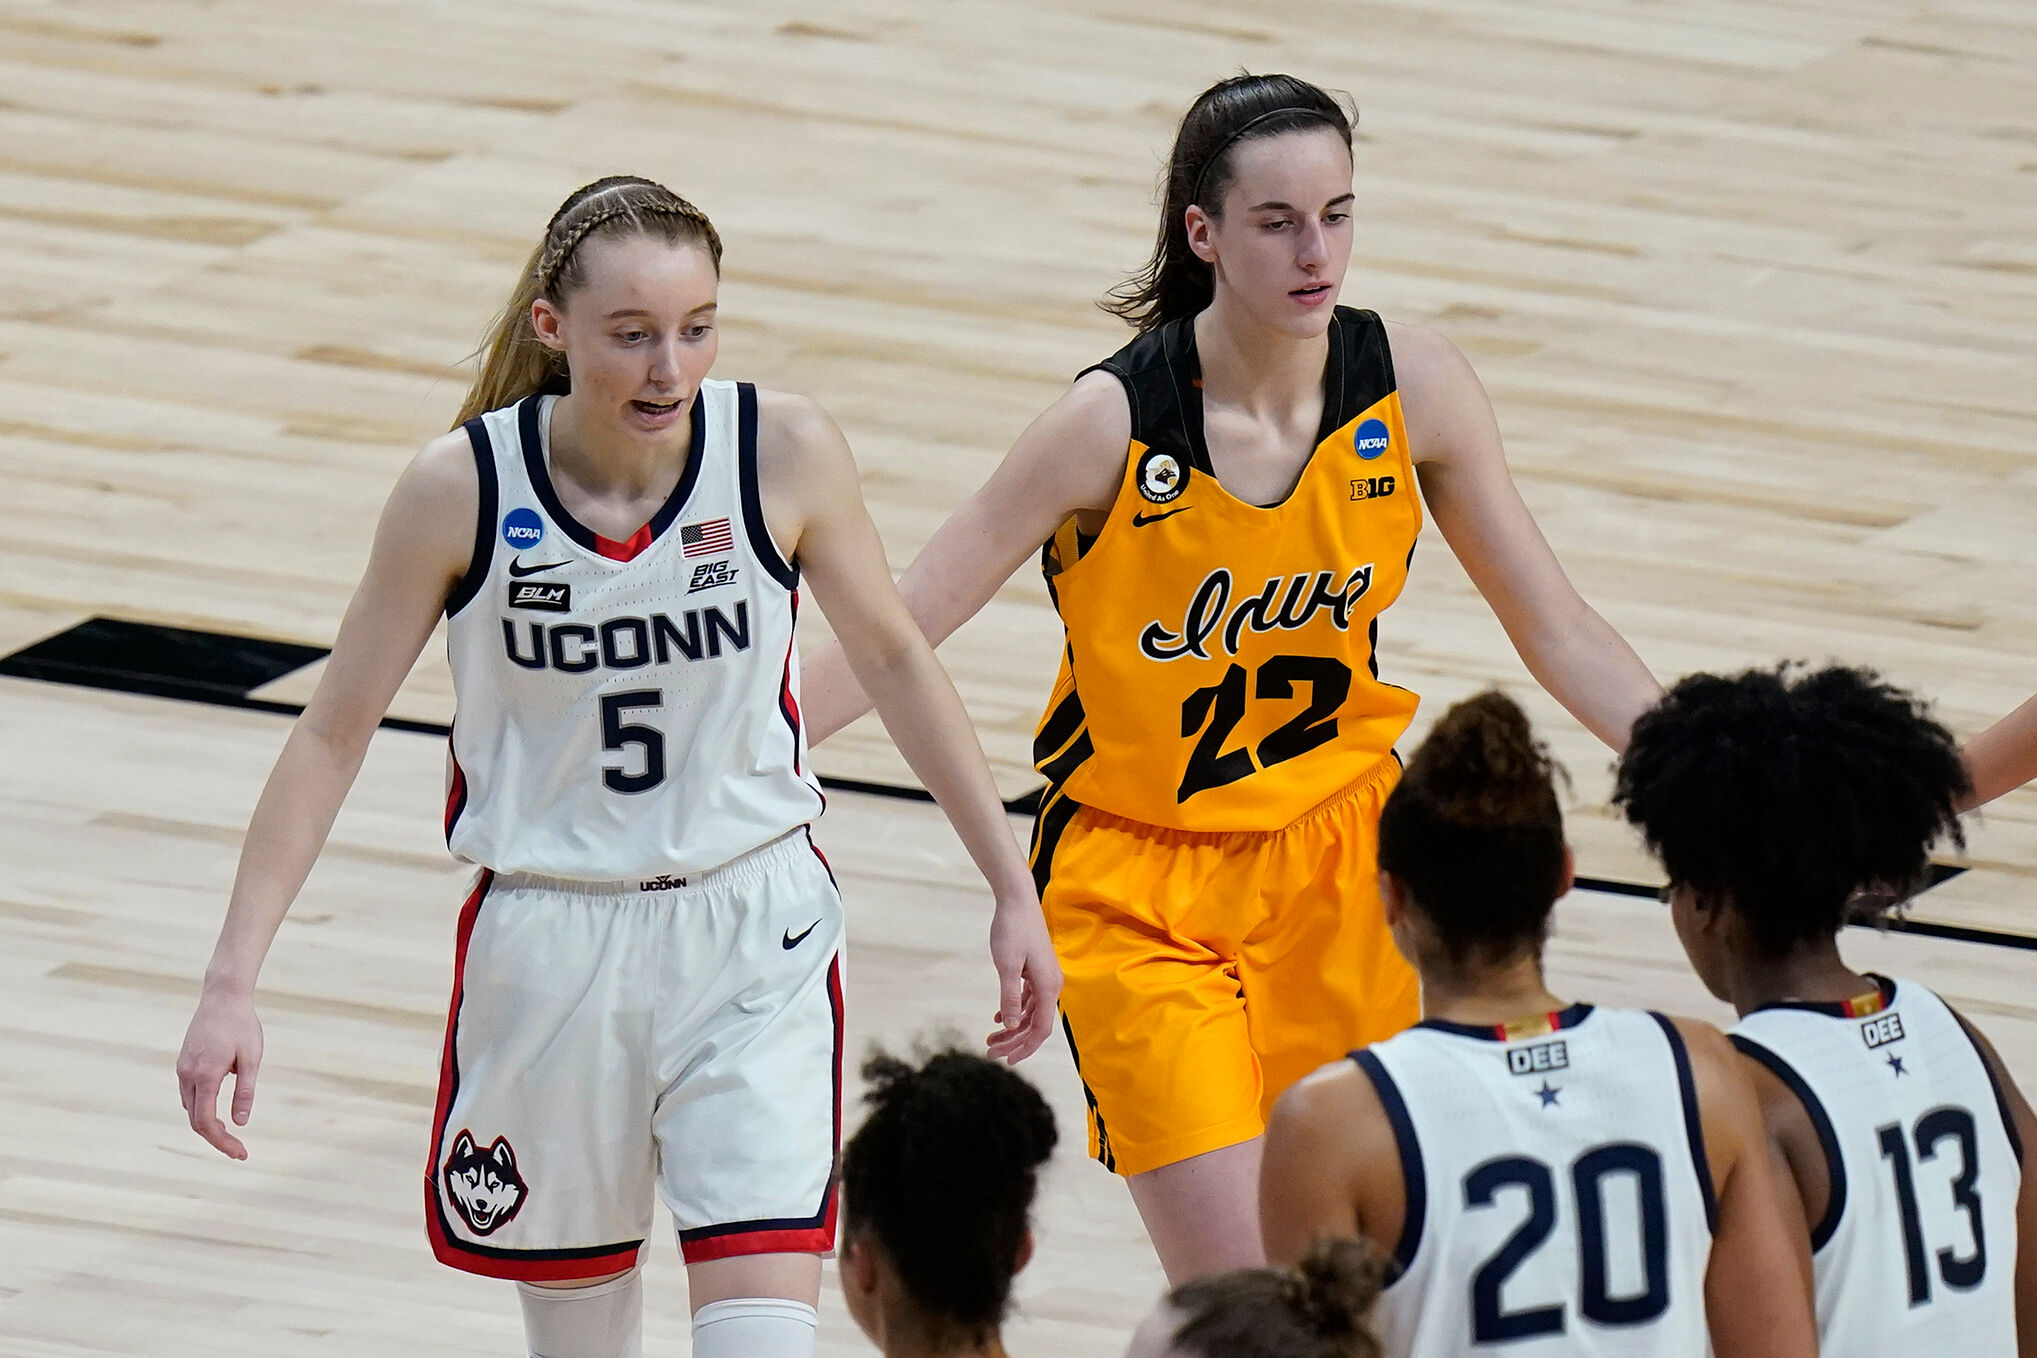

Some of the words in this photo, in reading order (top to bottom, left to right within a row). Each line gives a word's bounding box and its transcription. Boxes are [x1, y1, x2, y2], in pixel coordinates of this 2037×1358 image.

[1358, 438, 1388, 450] NCAA
[507, 526, 541, 539] NCAA
[689, 569, 740, 587] EAST
[693, 560, 730, 577] BIG
[516, 586, 566, 600] BLM
[501, 599, 751, 674] UCONN
[599, 688, 667, 795] 5
[1177, 654, 1352, 804] 22
[640, 878, 687, 891] UCONN
[1864, 1016, 1903, 1047] DEE
[1511, 1044, 1567, 1073] DEE
[1876, 1104, 1987, 1310] 13
[1460, 1140, 1671, 1347] 20
